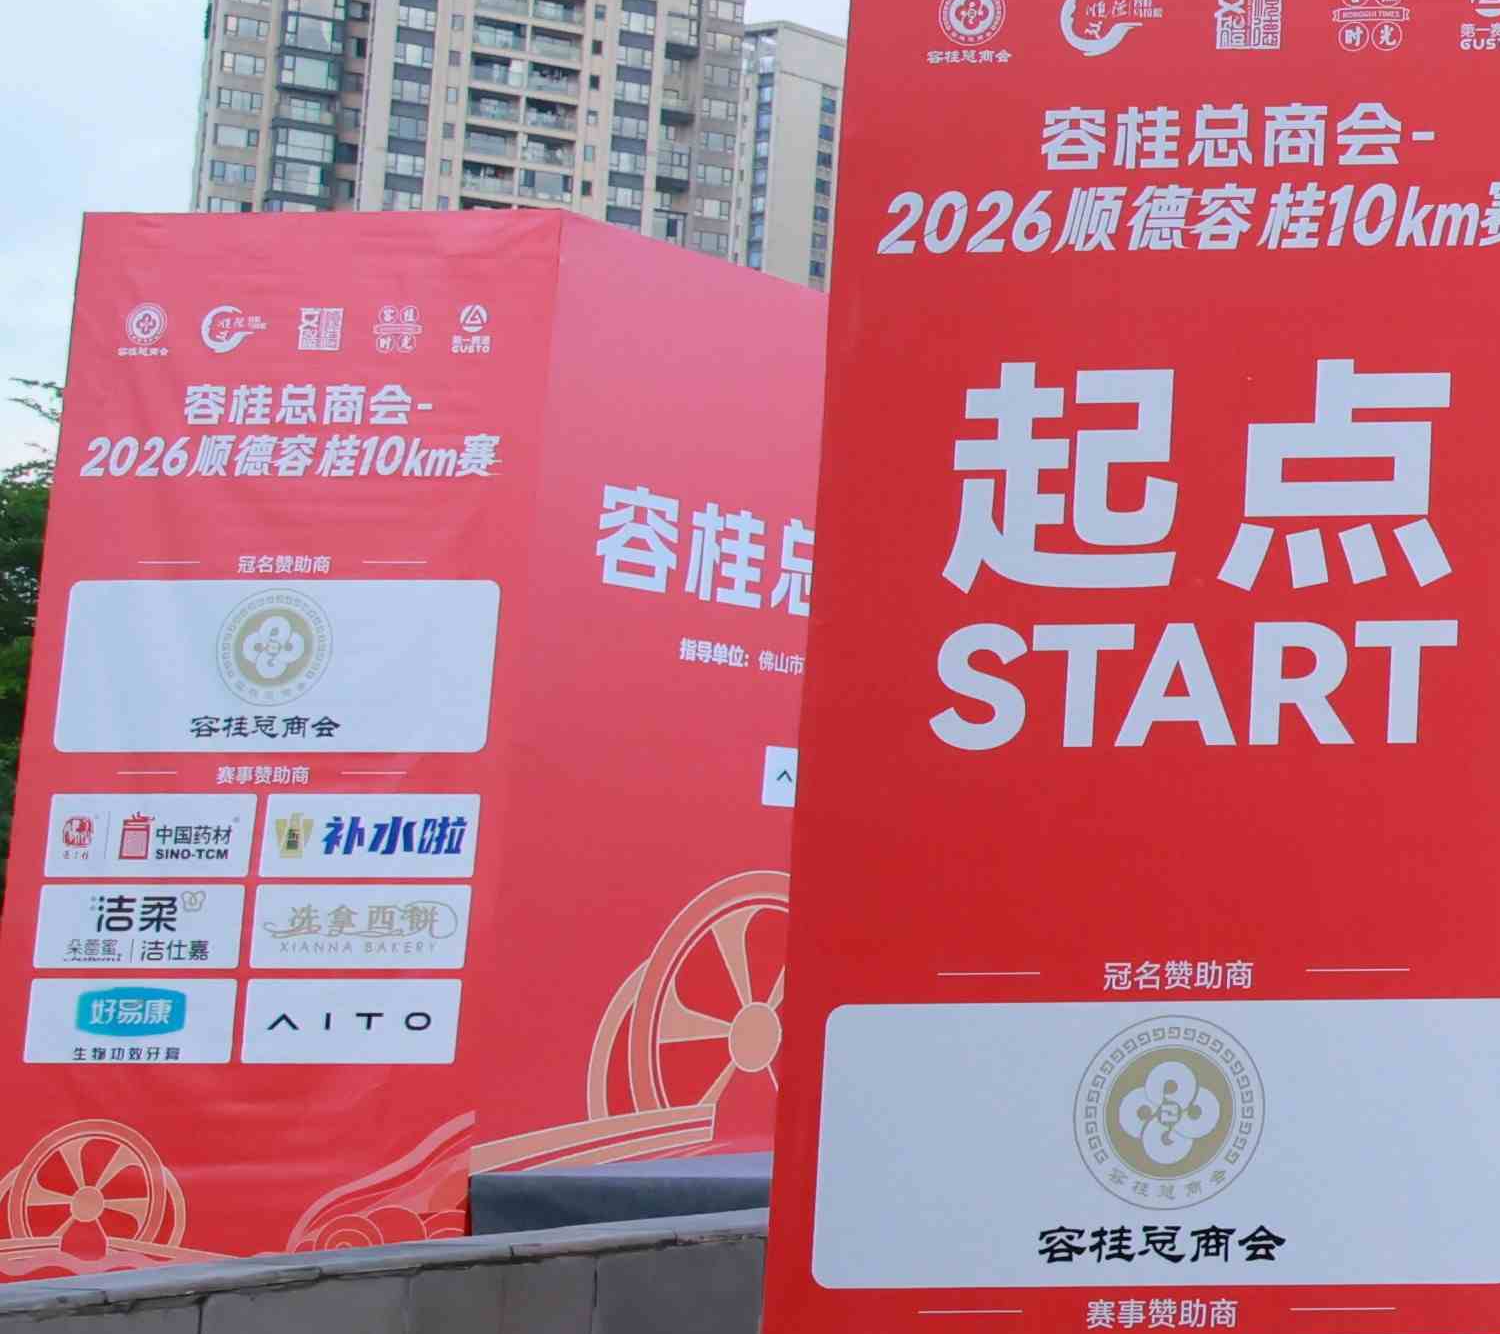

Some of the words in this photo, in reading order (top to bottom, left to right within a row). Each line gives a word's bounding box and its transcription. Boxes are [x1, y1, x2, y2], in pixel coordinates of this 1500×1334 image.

[1041, 102, 1436, 171] 容桂总商会-
[183, 383, 433, 426] 容桂总商会-
[80, 434, 502, 478] 2026顺德容桂10km赛
[942, 359, 1453, 594] 起点
[237, 555, 331, 575] 冠名赞助商
[929, 620, 1459, 750] START
[216, 765, 311, 786] 赛事赞助商
[156, 824, 232, 846] 中国药材
[323, 815, 468, 856] 补水啦
[156, 848, 230, 860] SINO-TCM
[96, 895, 178, 933] 洁柔
[140, 940, 210, 963] 洁仕嘉
[1103, 960, 1255, 992] 冠名赞助商
[1086, 1298, 1239, 1329] 赛事赞助商
